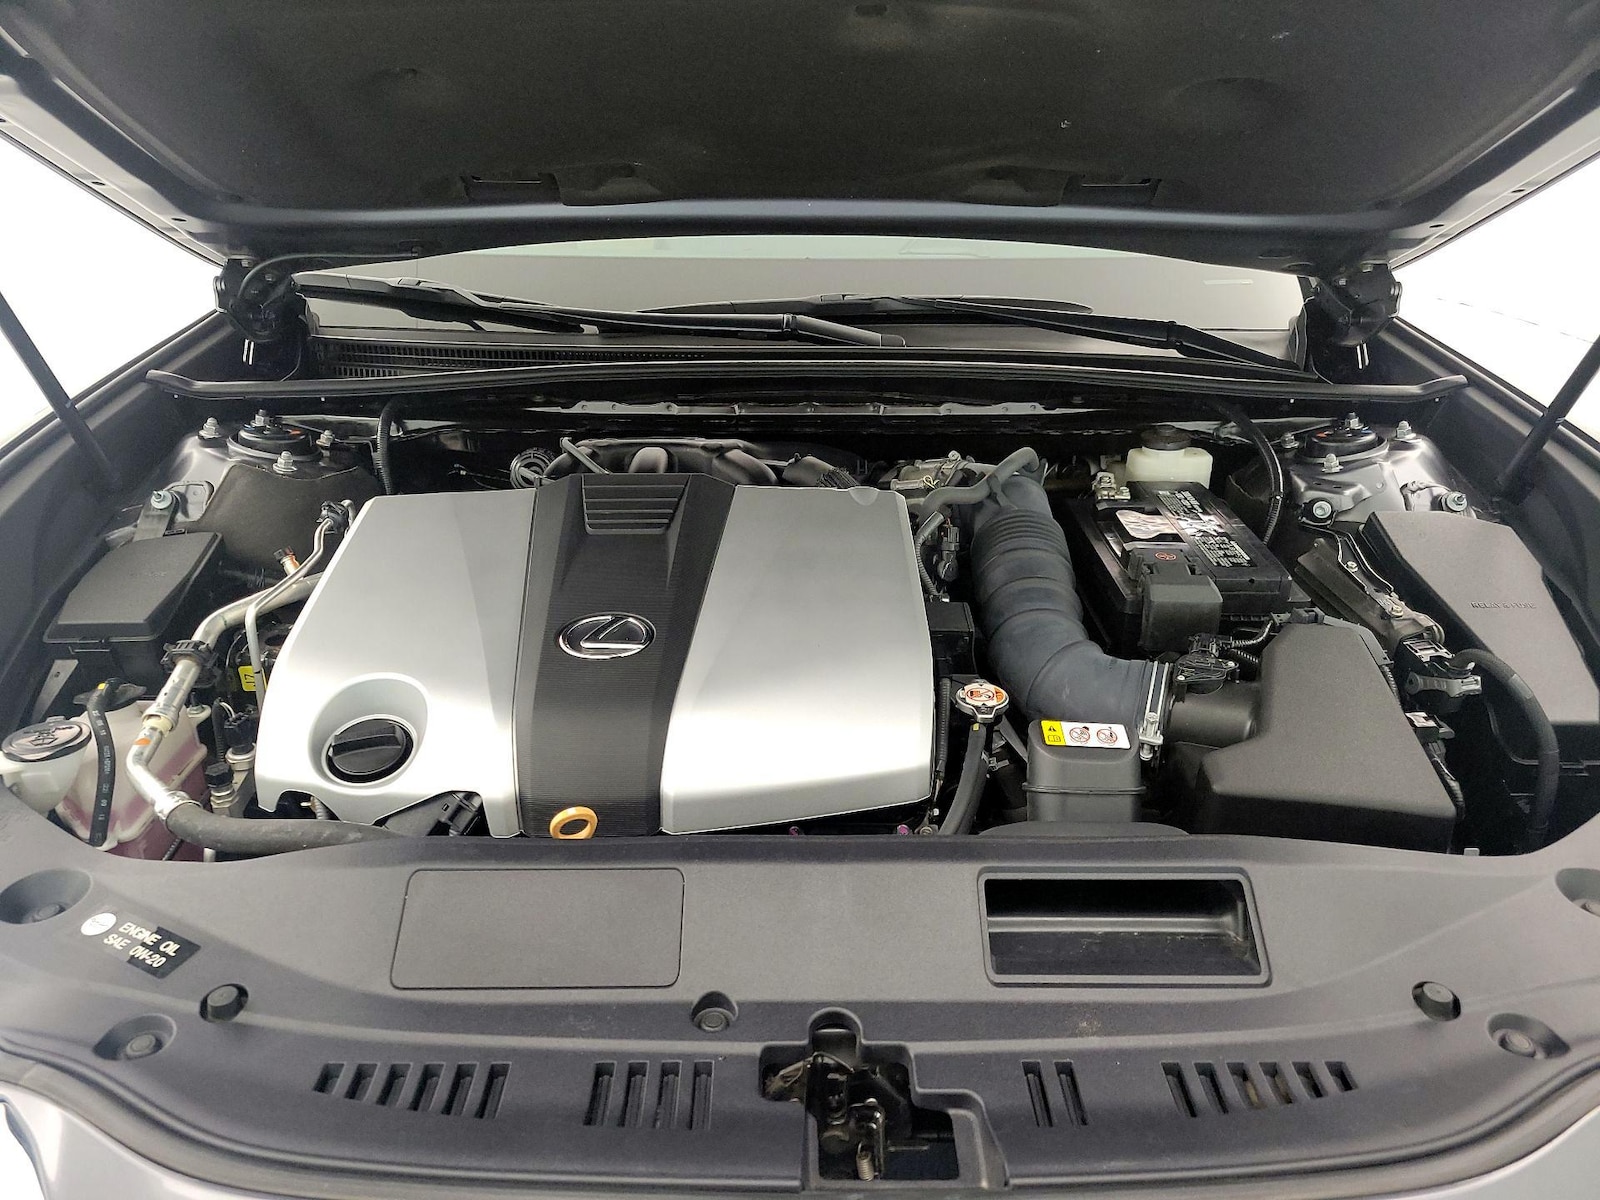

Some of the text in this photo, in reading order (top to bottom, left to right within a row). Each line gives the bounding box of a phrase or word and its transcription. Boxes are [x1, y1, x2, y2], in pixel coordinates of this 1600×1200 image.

[103, 933, 167, 968] SAE 0W-20
[118, 922, 162, 946] ENGINE
[159, 940, 181, 957] OIL
